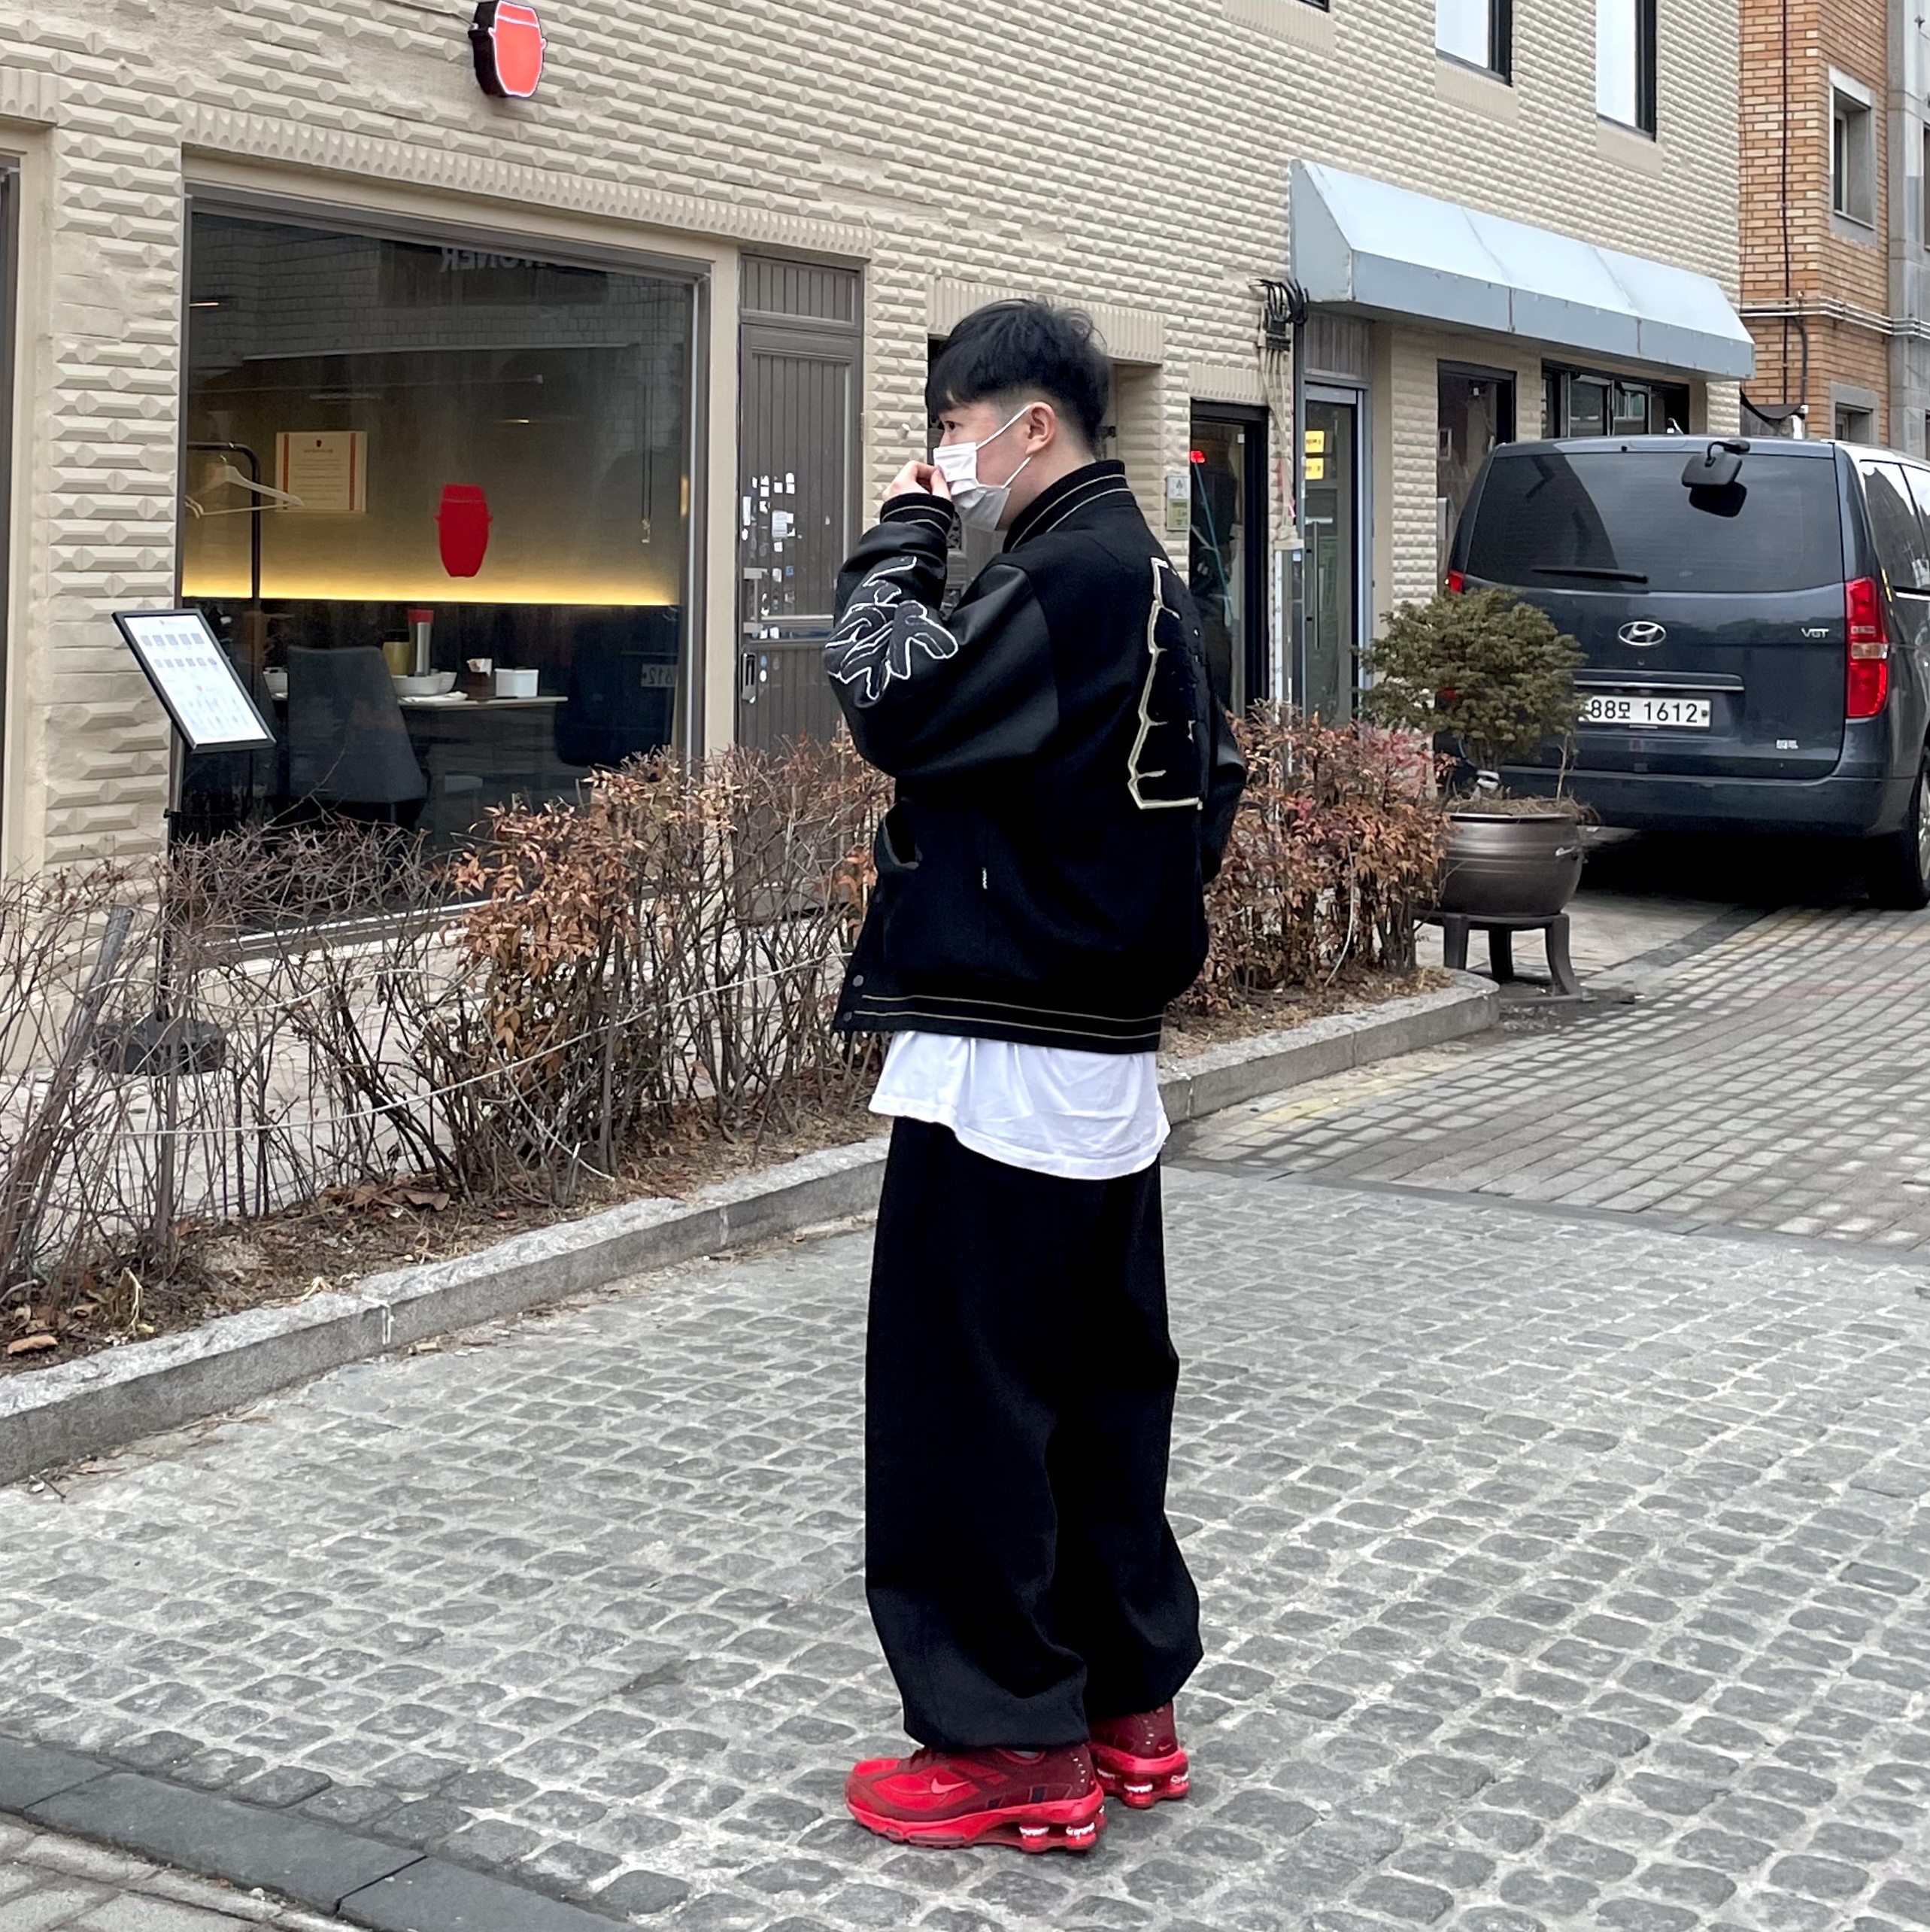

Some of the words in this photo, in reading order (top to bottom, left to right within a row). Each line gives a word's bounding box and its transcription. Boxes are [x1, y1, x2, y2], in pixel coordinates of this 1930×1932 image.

[1800, 627, 1829, 638] VGT
[1590, 699, 1631, 720] 88모
[1643, 701, 1698, 724] 1612
